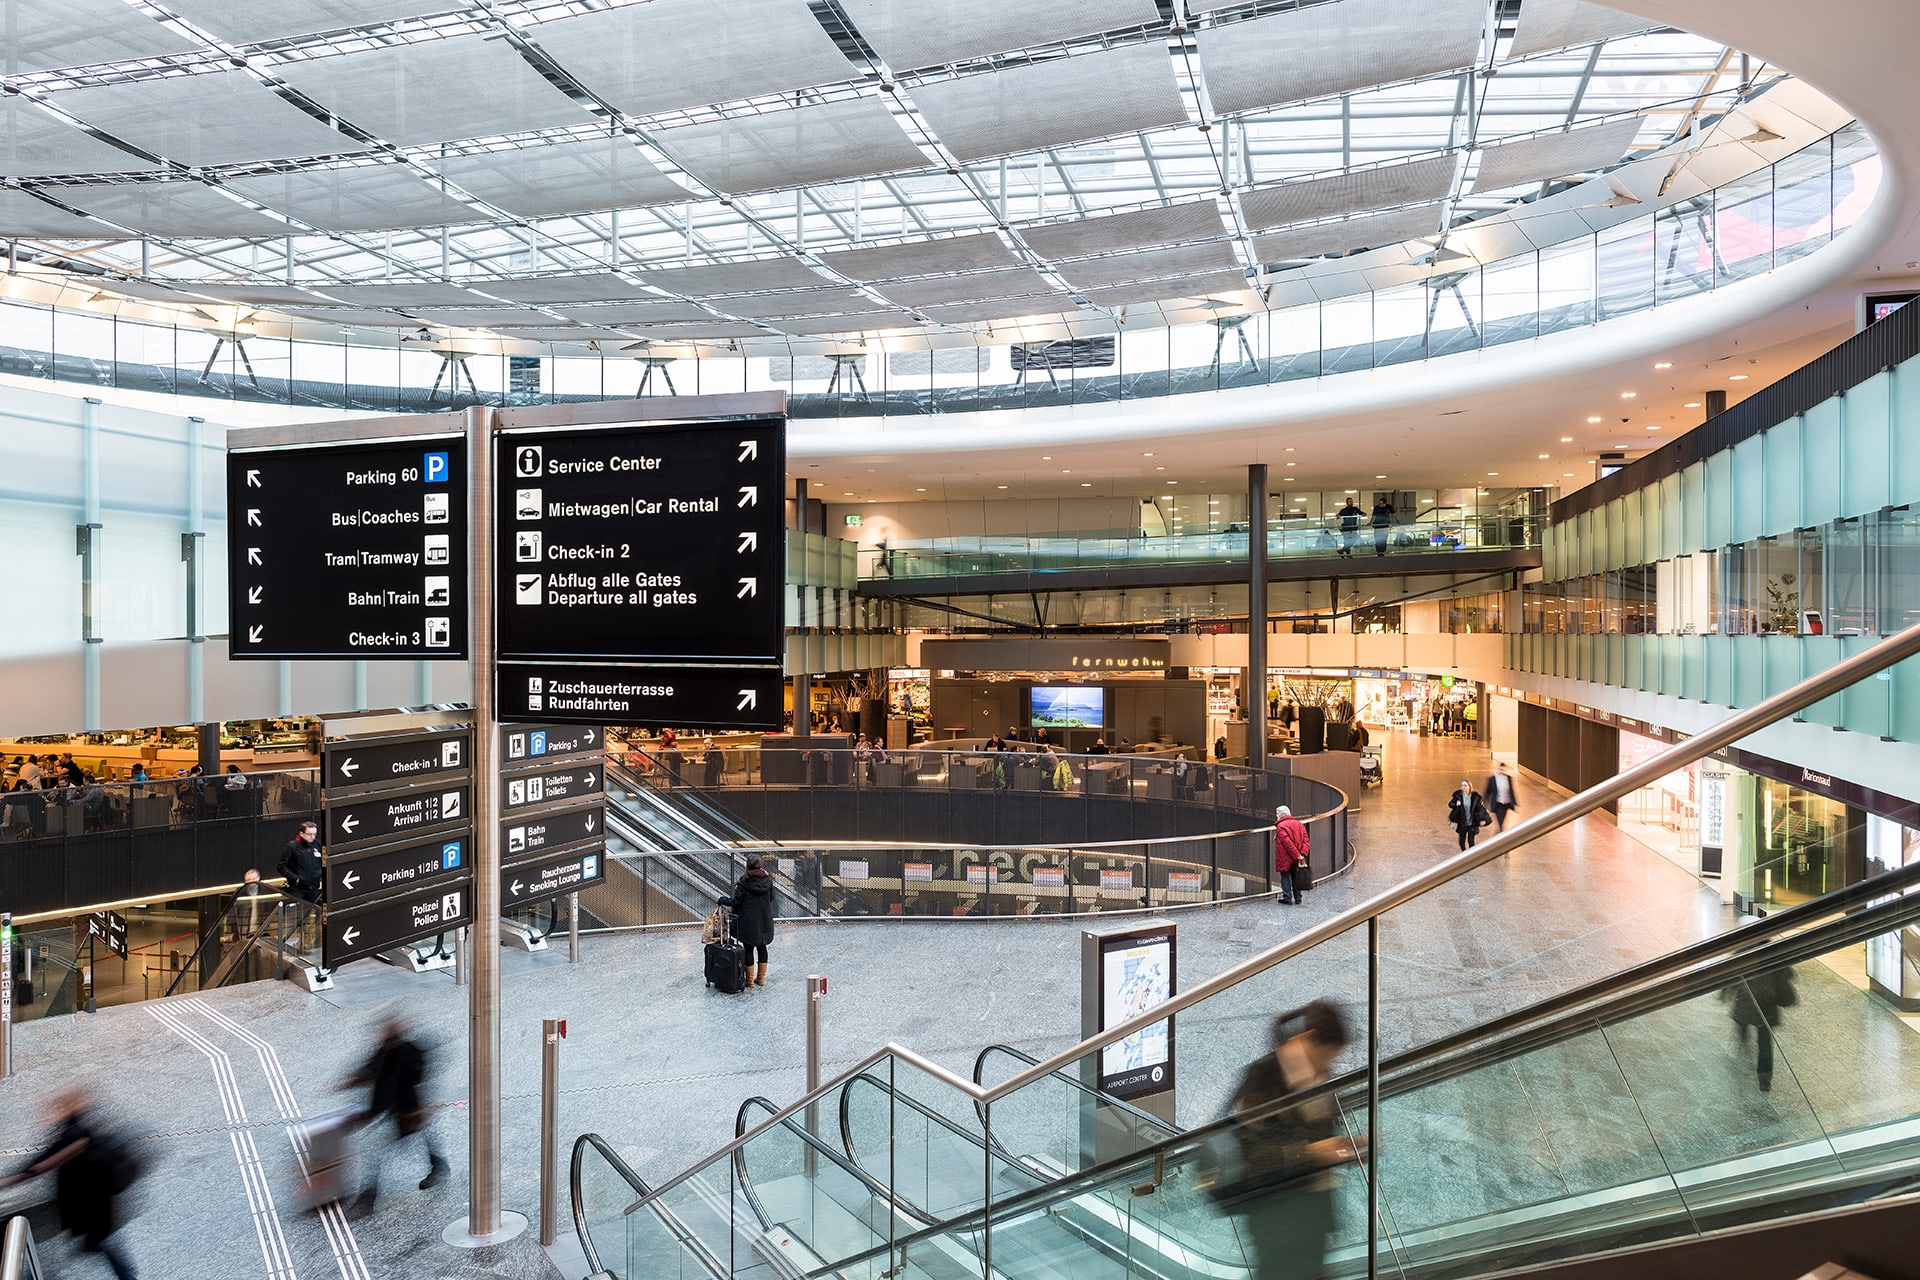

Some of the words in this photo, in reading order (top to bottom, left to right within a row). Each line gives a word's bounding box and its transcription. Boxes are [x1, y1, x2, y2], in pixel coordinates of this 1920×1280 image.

[428, 456, 444, 481] P
[549, 459, 604, 474] Service
[610, 456, 661, 471] Center
[347, 470, 396, 485] Parking
[402, 468, 418, 481] 60
[669, 497, 718, 513] Rental
[333, 509, 419, 527] Bus|Coaches
[325, 550, 419, 567] Tram|Tramway
[548, 545, 614, 559] Check-in
[621, 544, 629, 558] 2
[548, 573, 596, 590] Abflug
[602, 573, 629, 587] alle
[636, 572, 681, 587] Gates
[349, 590, 419, 607] Bahn|Train
[549, 591, 623, 607] Departure
[629, 590, 647, 604] all
[653, 590, 697, 607] gates
[349, 632, 407, 645] Check-in
[412, 632, 420, 645] 3
[1072, 656, 1149, 666] fernweh
[549, 681, 673, 697] Zuschauerterrasse
[550, 696, 629, 711] Rundfahrten
[549, 741, 571, 751] Parking
[392, 759, 430, 772] Check-in
[433, 758, 437, 767] 1
[545, 776, 572, 787] Toiletten
[1802, 768, 1831, 787] Marionnaud
[545, 785, 566, 797] Toilets
[388, 801, 422, 817] Ankunft
[393, 813, 421, 826] Arrival
[528, 826, 545, 837] Bahn
[528, 836, 544, 846] Train
[382, 869, 414, 884] Parking
[542, 863, 580, 880] Raucherzone
[530, 878, 559, 894] Smoking
[558, 871, 581, 887] Lounge
[413, 900, 438, 917] Polizei
[414, 912, 439, 928] Police
[1107, 1078, 1128, 1089] AIRPORT
[1129, 1074, 1148, 1084] CENTER
